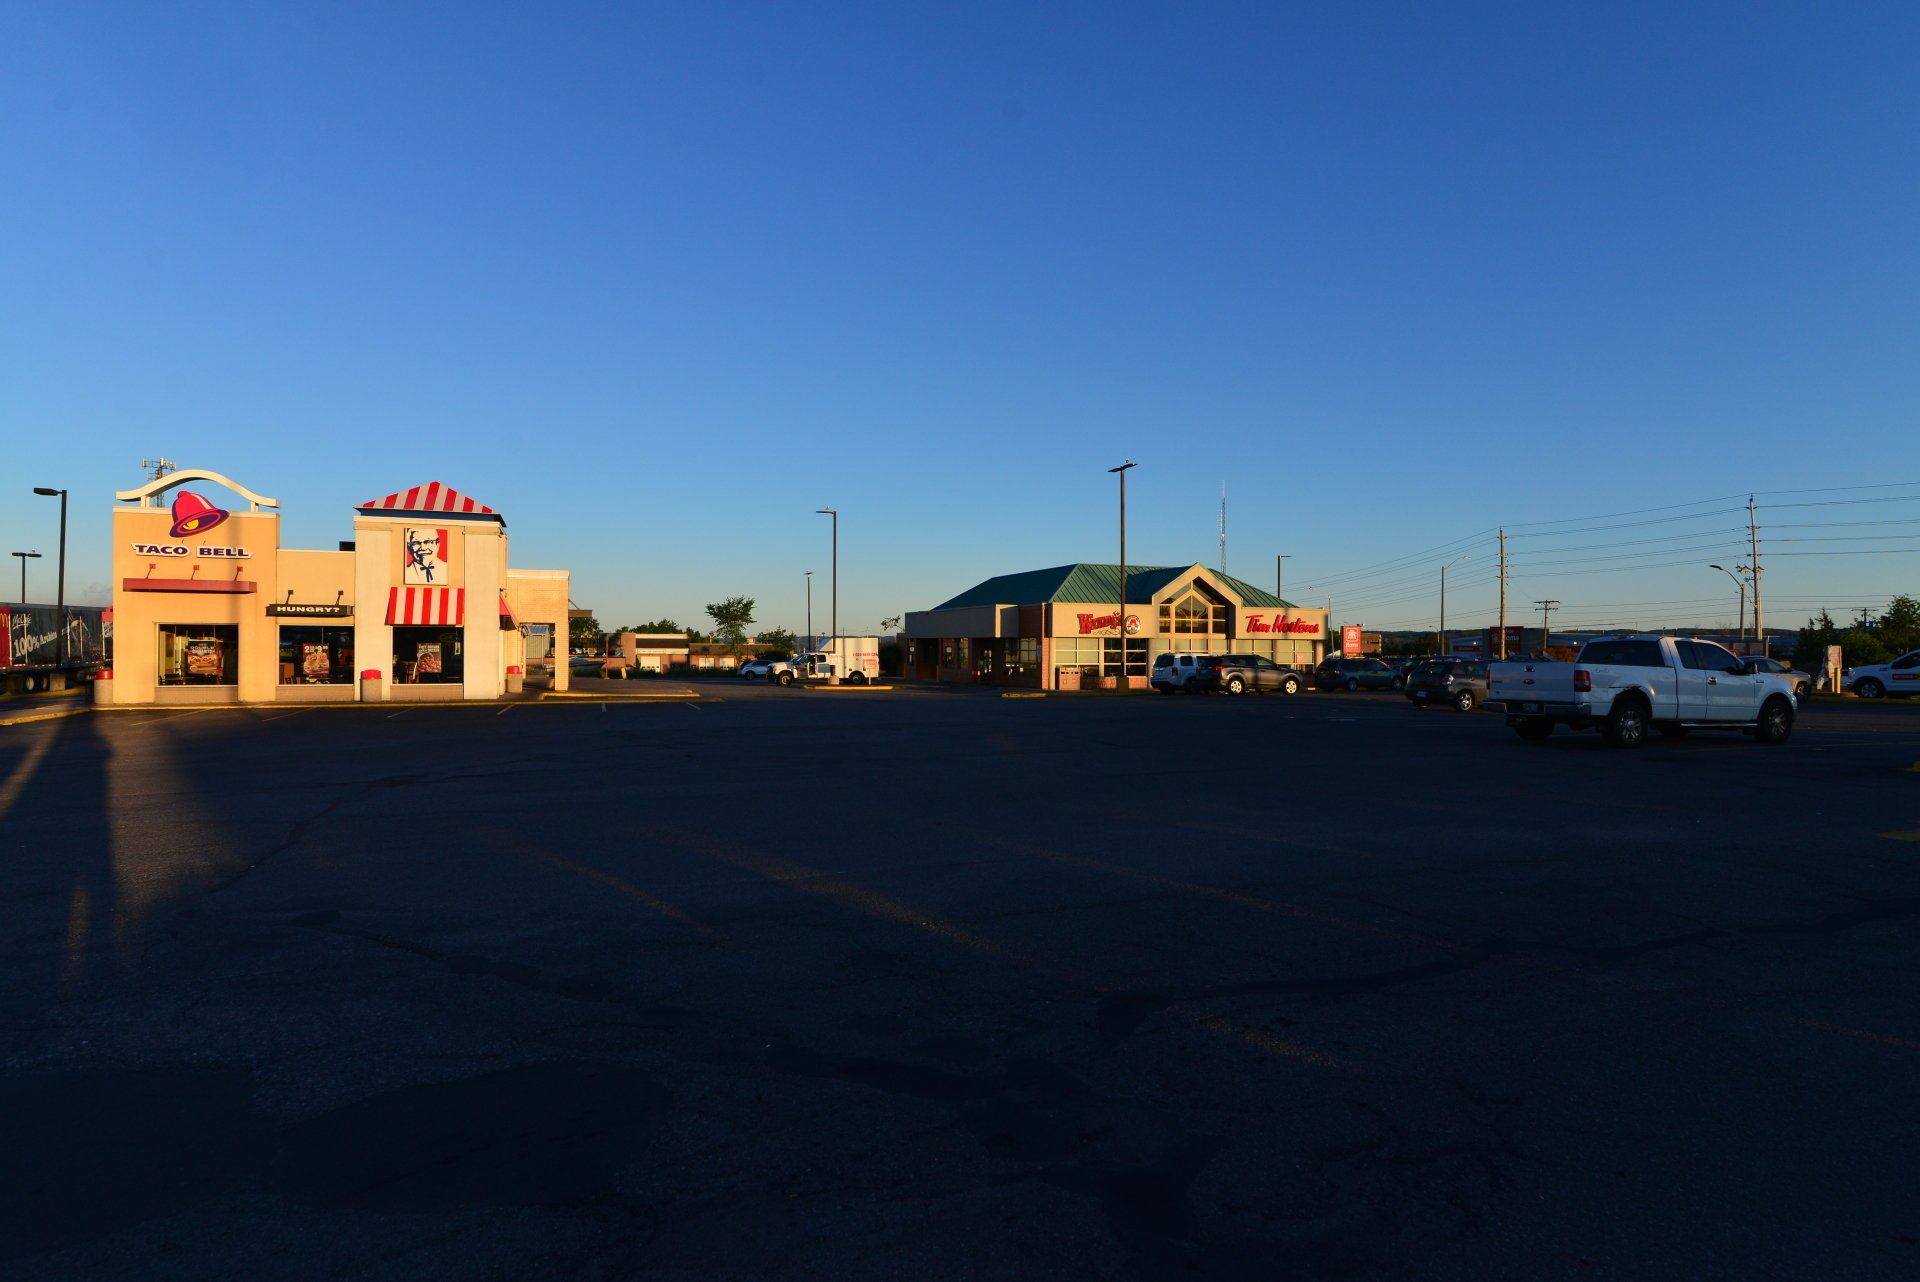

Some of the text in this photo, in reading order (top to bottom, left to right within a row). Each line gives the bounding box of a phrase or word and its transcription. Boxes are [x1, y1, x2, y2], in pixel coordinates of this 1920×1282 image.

[135, 544, 249, 557] TACO BELL
[1245, 614, 1320, 634] Tim Hortons
[14, 634, 40, 657] 100%
